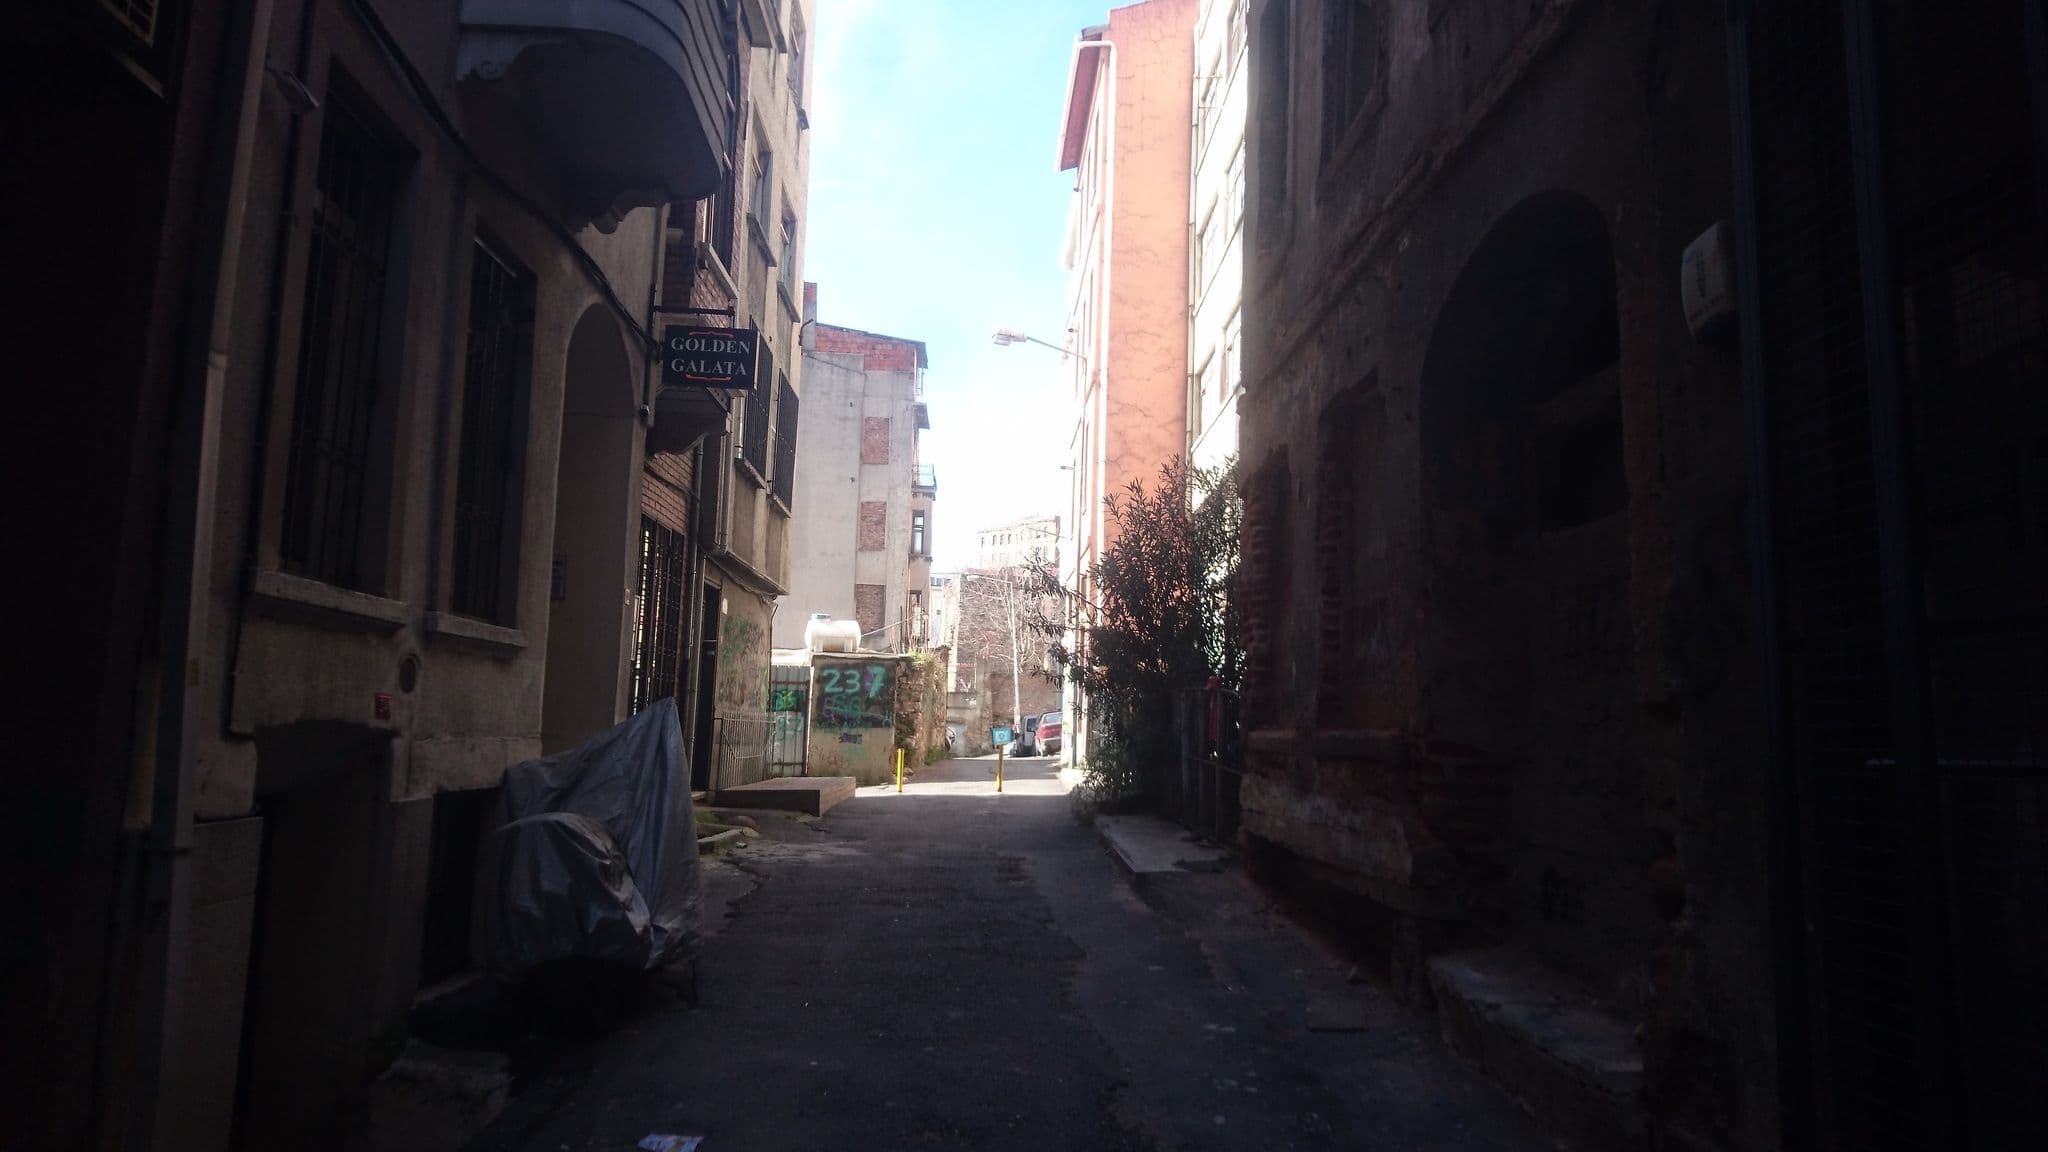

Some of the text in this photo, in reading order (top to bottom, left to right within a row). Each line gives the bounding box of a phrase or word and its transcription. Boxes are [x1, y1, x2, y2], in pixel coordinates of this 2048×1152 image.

[671, 337, 750, 354] GOLDEN
[671, 358, 747, 375] GALATA
[821, 666, 886, 698] 237
